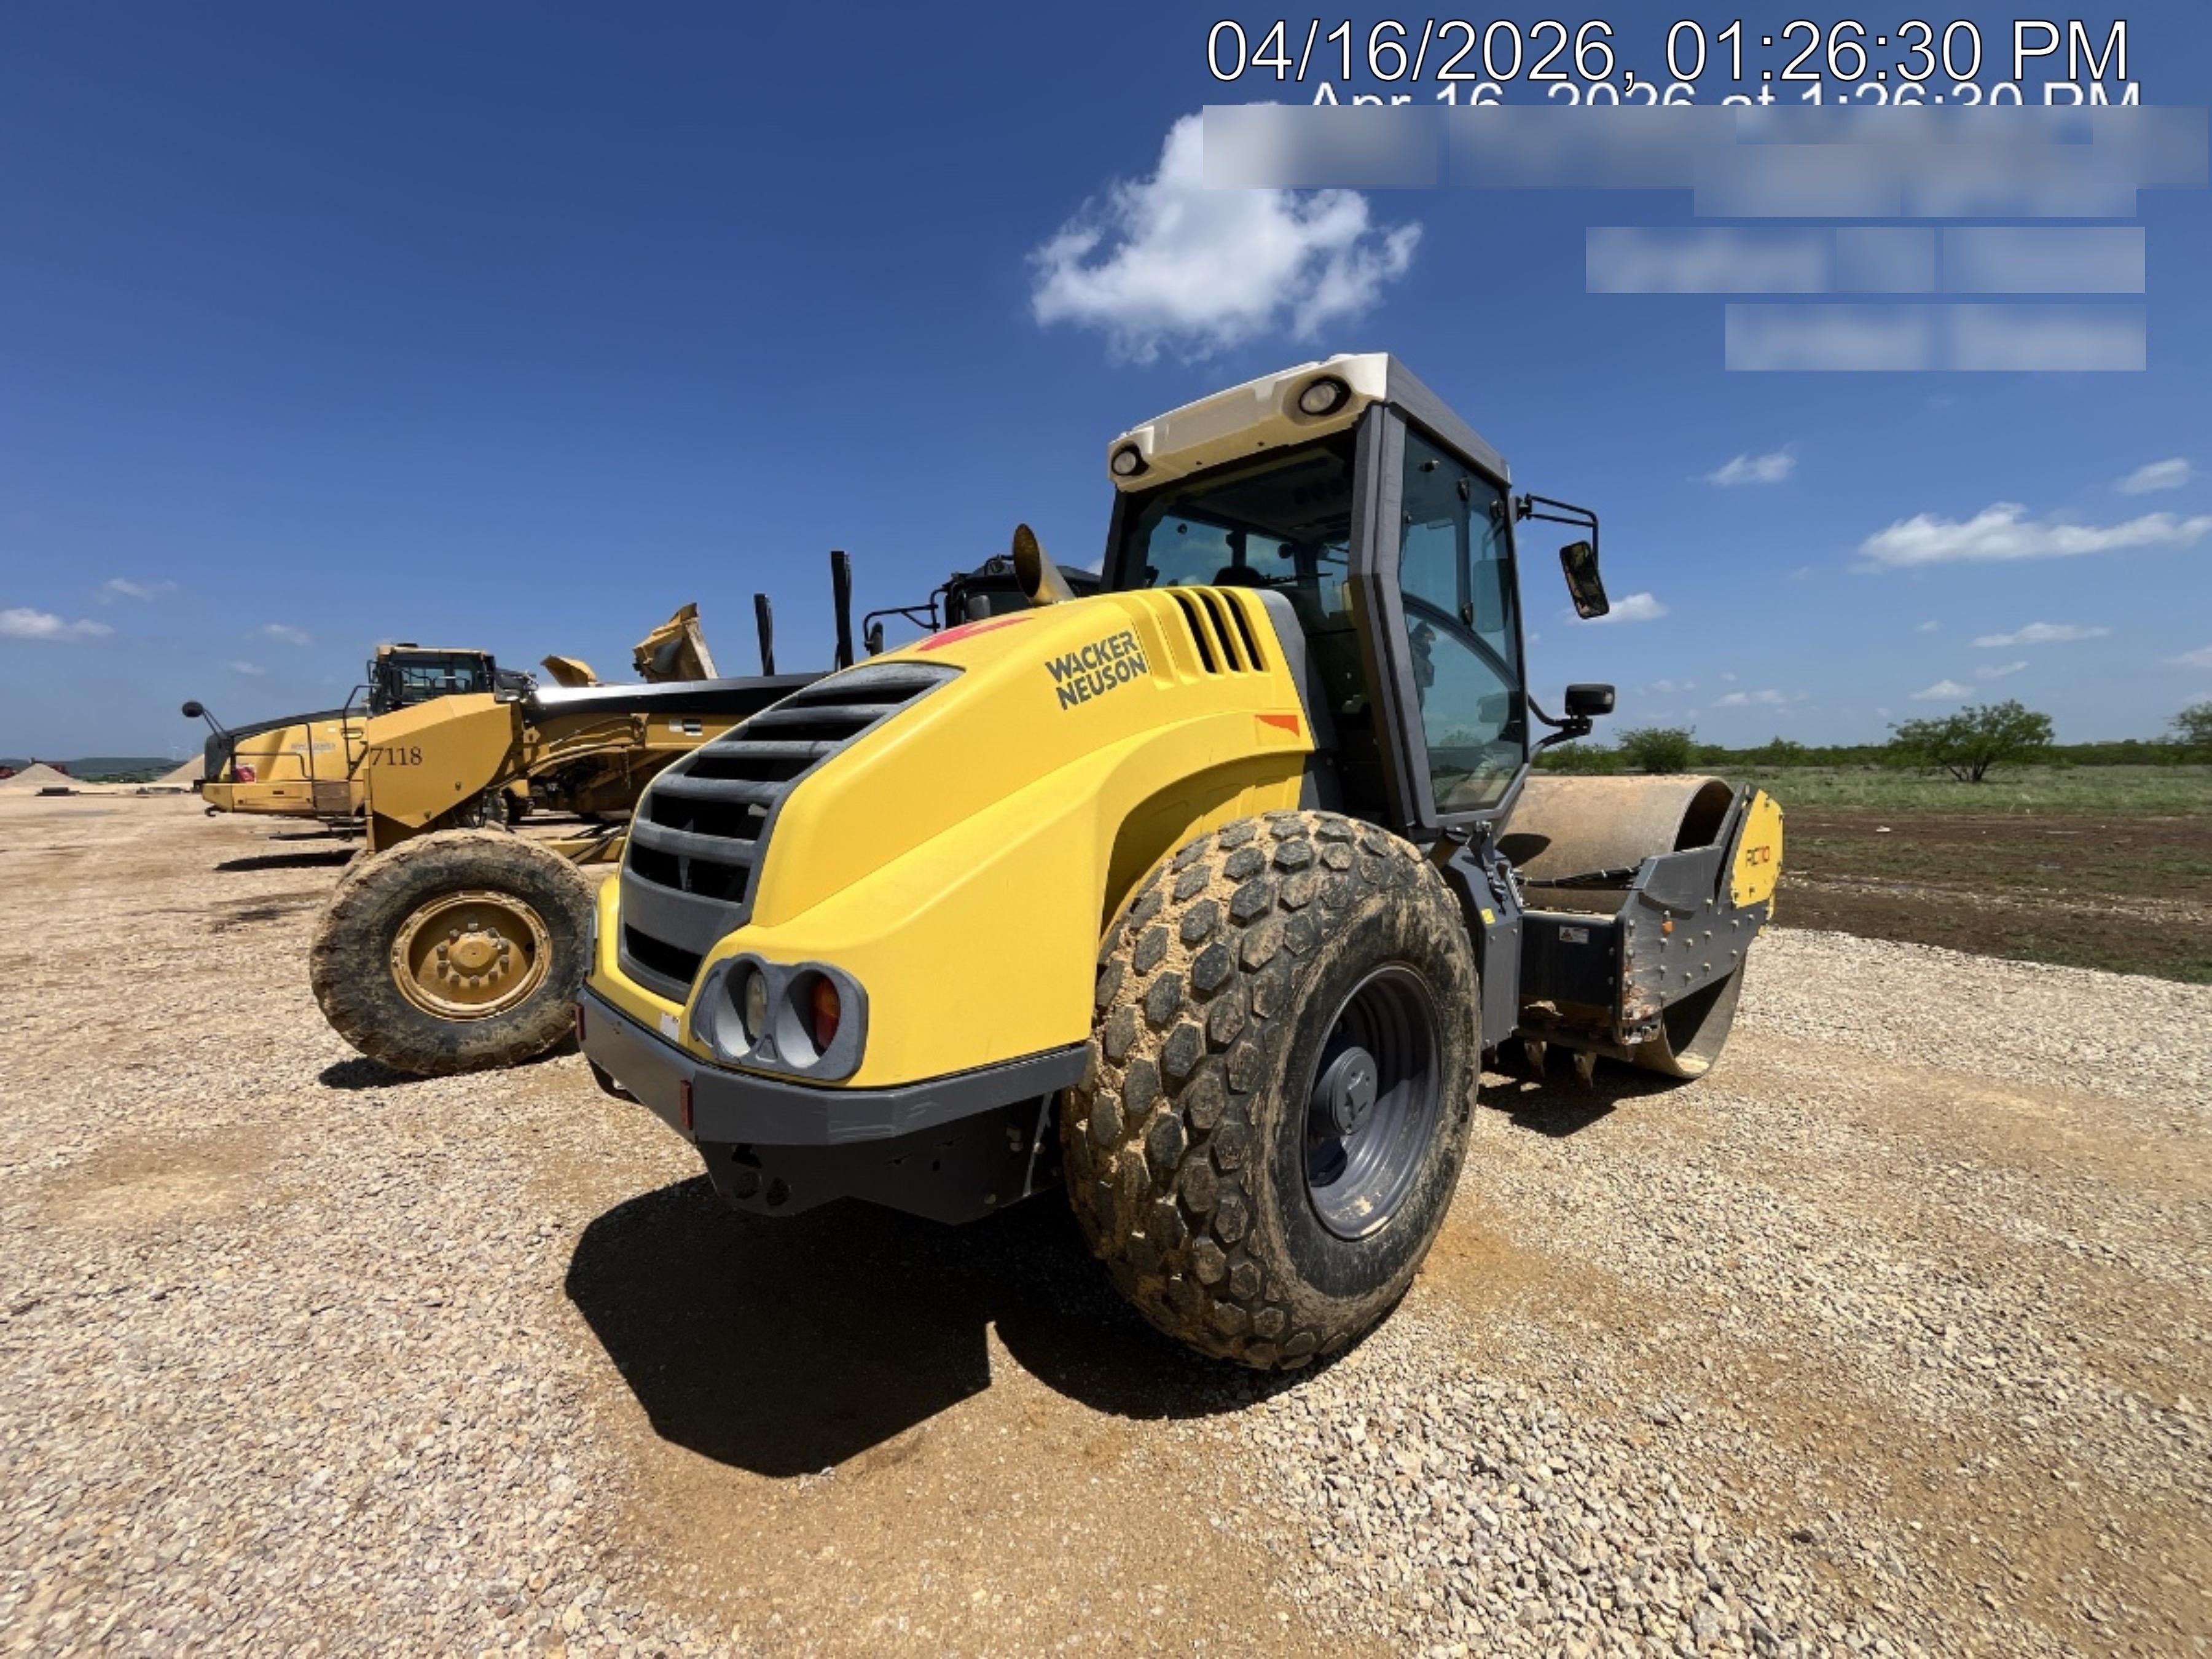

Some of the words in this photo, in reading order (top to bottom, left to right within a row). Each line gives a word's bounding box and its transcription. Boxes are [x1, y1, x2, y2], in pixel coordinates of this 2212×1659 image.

[1045, 630, 1137, 683] WACKER
[1056, 653, 1147, 710] NEUSON
[370, 747, 423, 766] 7118
